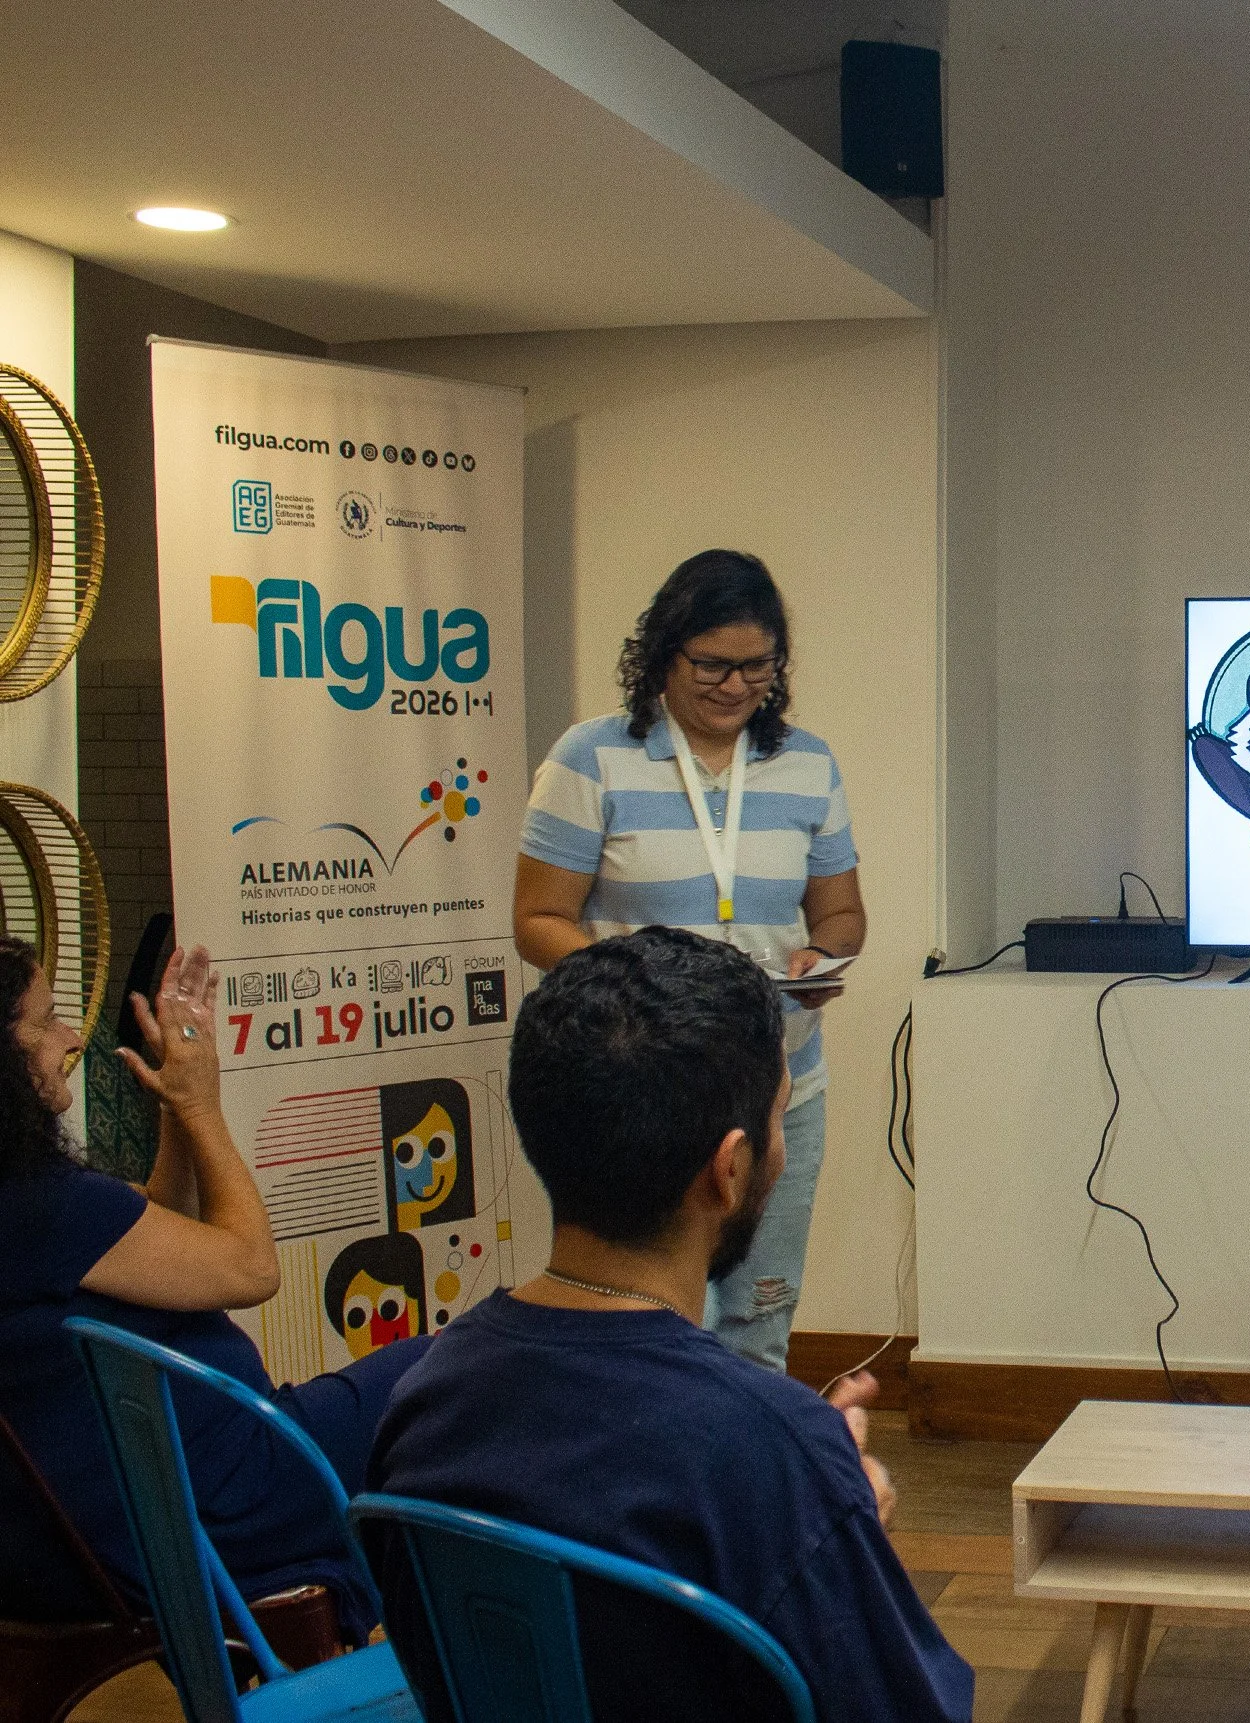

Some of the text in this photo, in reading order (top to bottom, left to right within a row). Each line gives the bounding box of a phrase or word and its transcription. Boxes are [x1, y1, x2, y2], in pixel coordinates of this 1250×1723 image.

[214, 424, 330, 455] filgua.com
[274, 502, 315, 512] Gremial de
[275, 509, 315, 520] Editores de
[275, 518, 316, 528] Guatemala
[385, 517, 466, 533] Cultura y Deportes
[256, 577, 490, 711] filgua
[390, 689, 459, 716] 2026
[240, 858, 374, 885] ALEMANIA
[241, 882, 377, 900] PAÍS INVITADO DE HONOR
[241, 898, 485, 925] Historias que construyen puentes
[227, 996, 455, 1056] 7 al 19 julio
